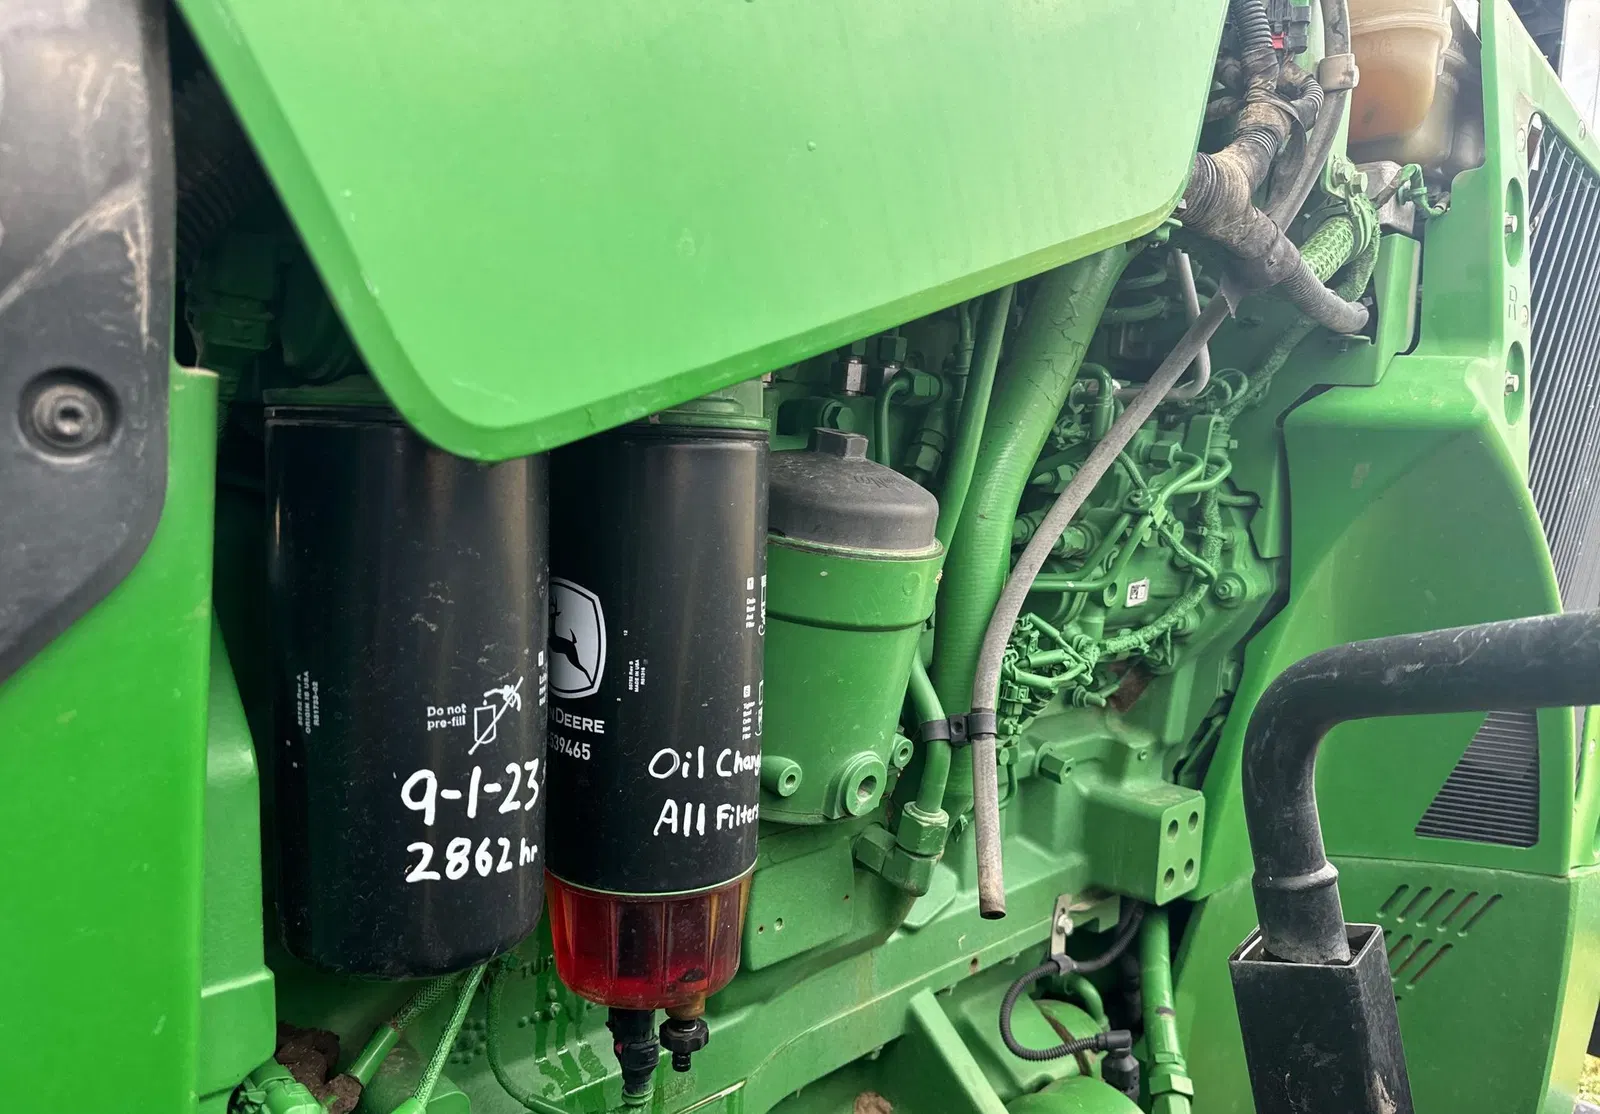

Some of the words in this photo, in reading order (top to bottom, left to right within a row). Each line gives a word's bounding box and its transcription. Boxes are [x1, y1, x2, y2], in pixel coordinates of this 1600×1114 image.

[427, 706, 444, 717] Do
[447, 703, 467, 714] not
[427, 715, 467, 731] pre-fill
[556, 707, 605, 734] DEERE
[548, 730, 591, 760] 539465
[648, 745, 705, 779] Oil
[400, 758, 539, 826] 9-1-23
[653, 798, 706, 837] All
[405, 837, 513, 883] 2862
[519, 837, 538, 867] hr
